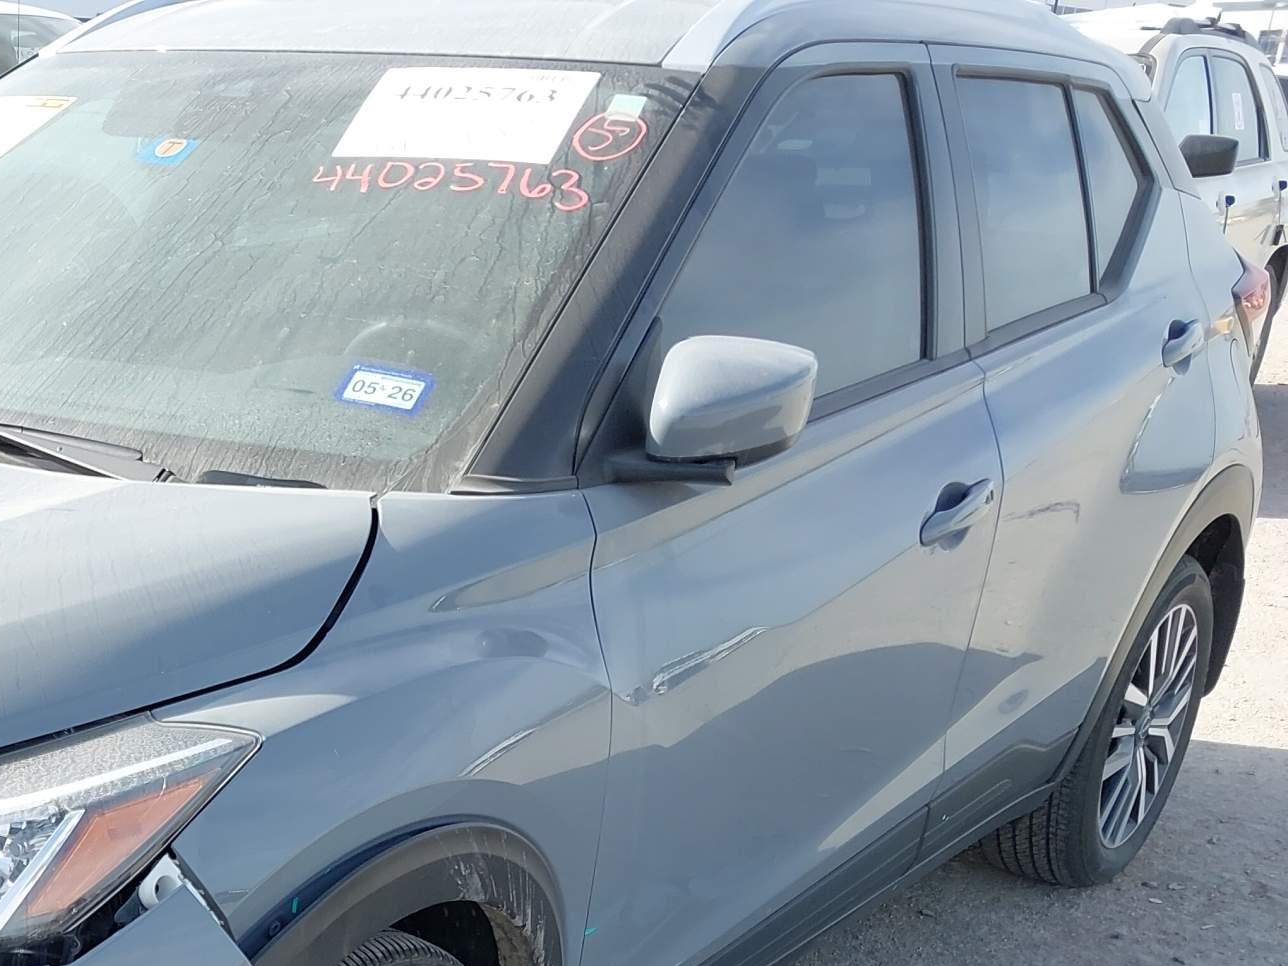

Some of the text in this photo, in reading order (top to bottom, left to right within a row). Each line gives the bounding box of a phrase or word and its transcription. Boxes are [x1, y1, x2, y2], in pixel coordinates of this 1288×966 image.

[393, 84, 559, 104] 44025763
[312, 161, 590, 212] 44025763
[351, 379, 417, 403] 05 26
